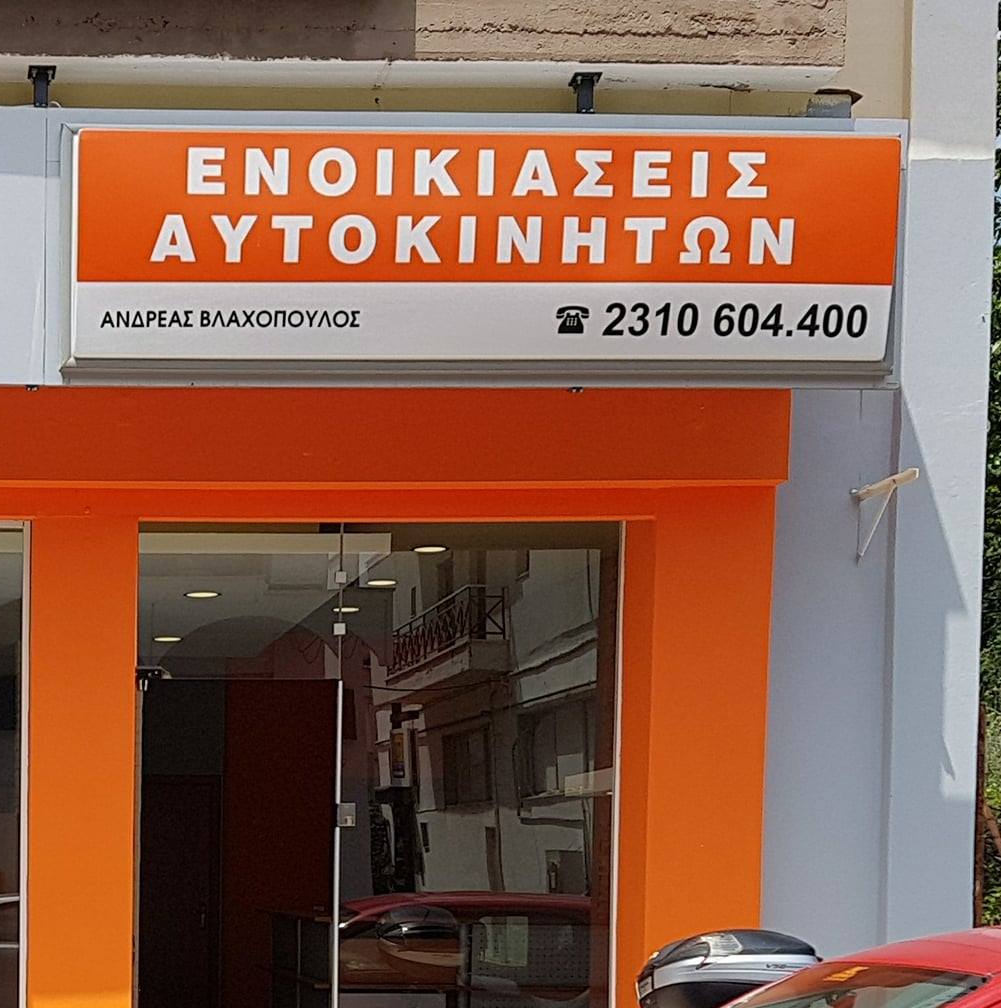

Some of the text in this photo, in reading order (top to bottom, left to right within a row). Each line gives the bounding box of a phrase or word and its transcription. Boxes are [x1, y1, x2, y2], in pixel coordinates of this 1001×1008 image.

[185, 146, 769, 200] ΕΝΟΙΚΙΑΣΕΙΣ
[149, 213, 796, 267] ΑΥΤΟΚΙΝΗΤΩΝ
[100, 310, 361, 328] ΑΝΔΡΕΑΣ ΒΛΑΧΟΠΟΥΛΟΣ
[602, 302, 868, 338] 2310 604.400
